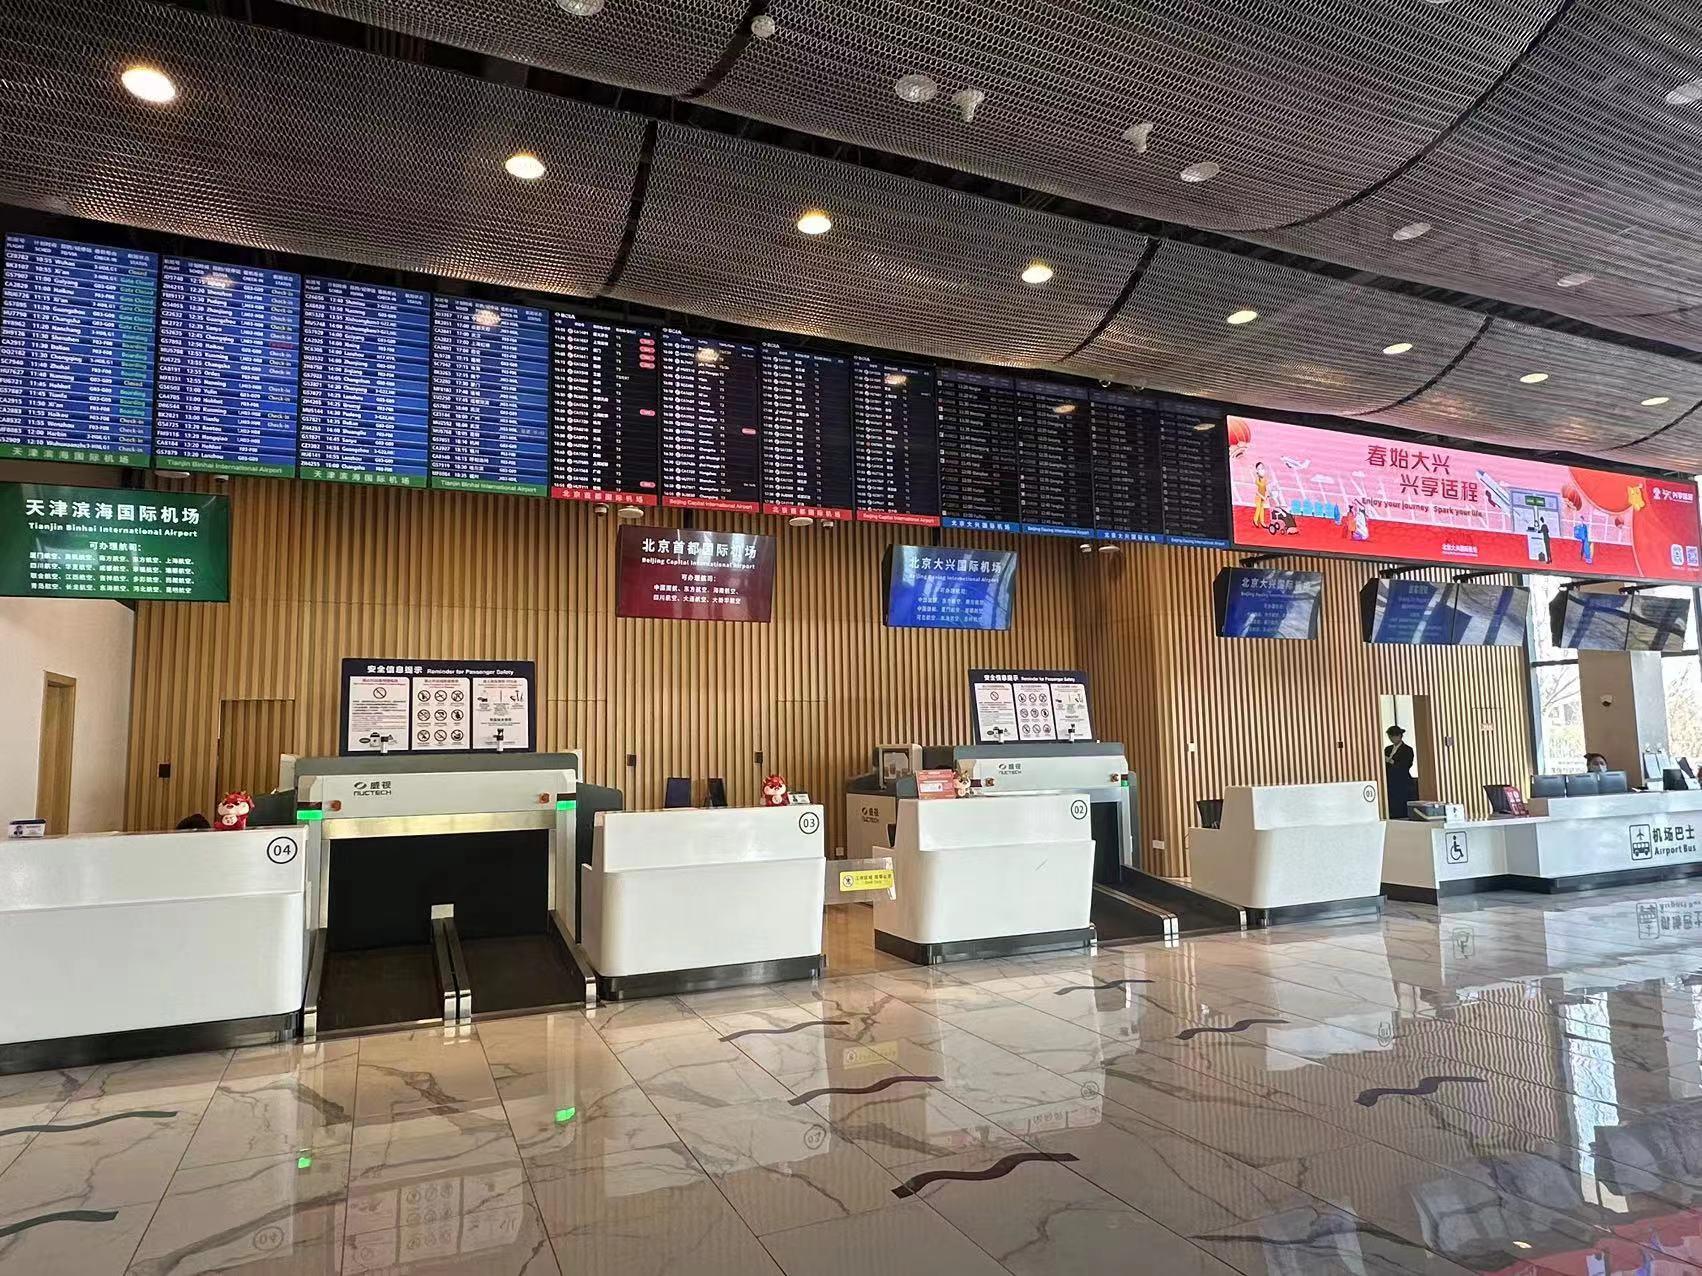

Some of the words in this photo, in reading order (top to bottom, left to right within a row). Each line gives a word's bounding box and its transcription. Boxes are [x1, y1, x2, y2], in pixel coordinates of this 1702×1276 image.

[54, 278, 78, 287] Guiyang
[207, 289, 232, 297] Shenzhen
[207, 298, 227, 306] Pudong
[53, 306, 85, 316] Guangzhou
[52, 316, 80, 324] Changsha
[206, 317, 236, 325] Guangzhou
[52, 326, 81, 334] Nanchang
[205, 334, 234, 344] Chongqing
[50, 354, 82, 362] Chongqing
[12, 448, 129, 463] 天津滨海国际机场
[1366, 445, 1450, 474] 春始大兴
[168, 459, 191, 468] Tianjin
[216, 463, 258, 472] International
[259, 466, 282, 474] Airport
[314, 470, 409, 485] 天津滨海国际机场
[442, 480, 460, 488] Tianjin
[480, 483, 516, 491] International
[1400, 474, 1478, 502] 兴享适程
[562, 490, 644, 503] 北京首都国际机场
[26, 500, 200, 524] 天津滨海国际机场
[1362, 498, 1382, 507] Enjoy
[1384, 500, 1400, 509] your
[1402, 501, 1430, 512] journey
[1433, 506, 1453, 515] Spark
[28, 522, 63, 532] Tianjin
[66, 524, 97, 532] Binhai
[100, 526, 162, 536] International
[164, 529, 198, 538] Airport
[642, 538, 756, 559] 北京首都国际机场
[666, 558, 689, 566] Capital
[691, 560, 732, 568] International
[910, 557, 1001, 573] 北京大兴国际机场
[367, 666, 423, 674] 安全信息提示
[371, 781, 391, 789] 威视
[1075, 806, 1084, 814] 02
[804, 819, 815, 828] 03
[1652, 824, 1695, 842] 机场巴士
[274, 845, 291, 856] 04
[1655, 846, 1682, 856] Airport
[1684, 844, 1696, 852] Bus
